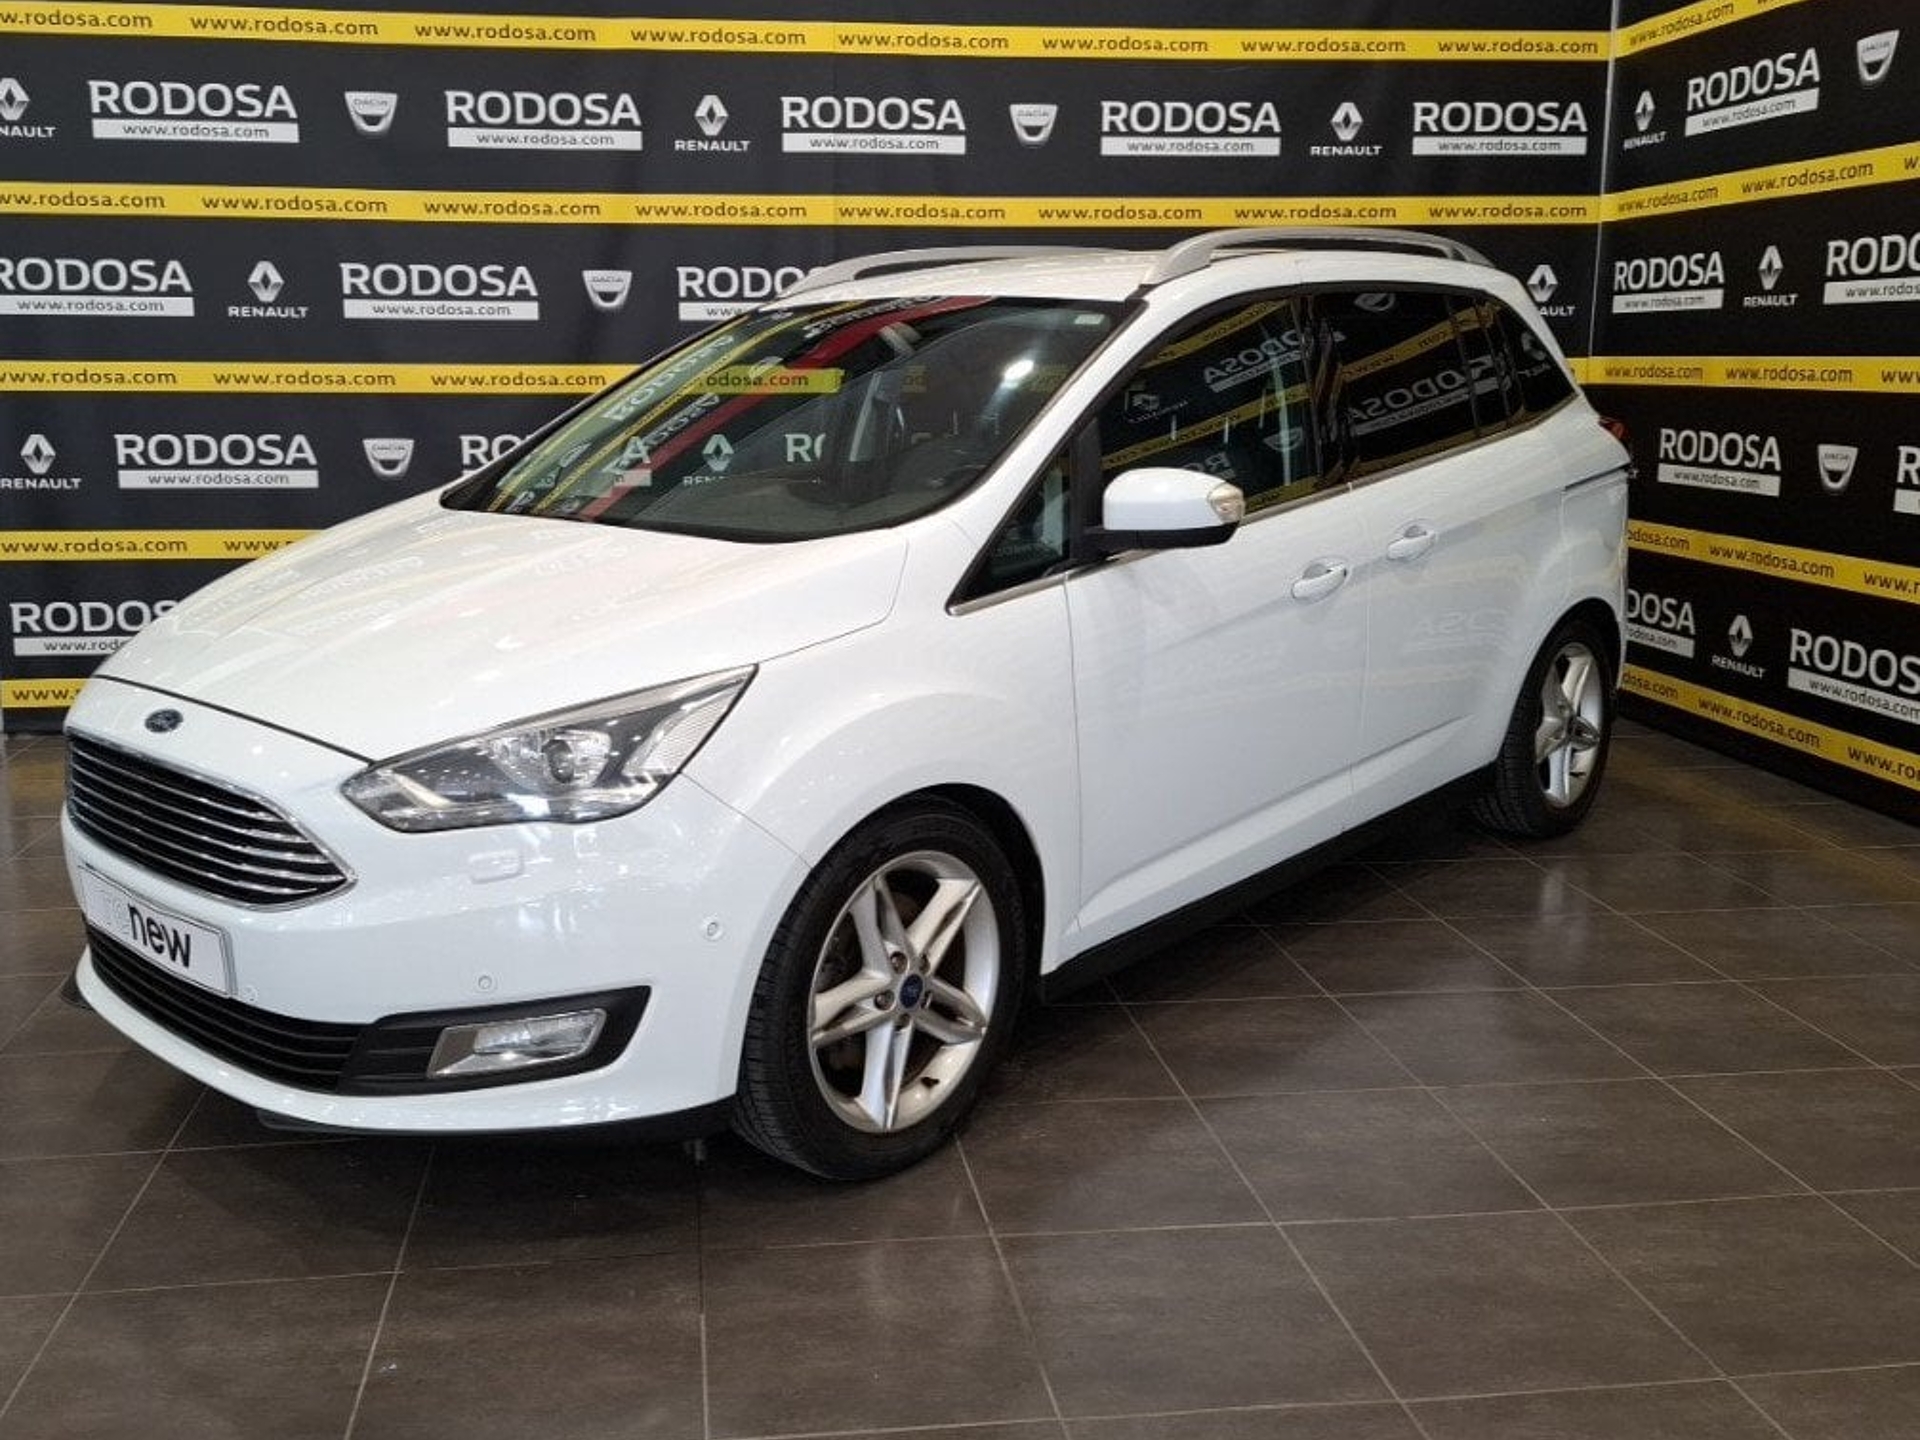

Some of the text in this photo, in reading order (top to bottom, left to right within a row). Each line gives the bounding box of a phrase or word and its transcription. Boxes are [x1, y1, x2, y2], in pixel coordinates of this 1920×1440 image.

[0, 9, 1598, 55] w.rodosa.com www.rodosa.com www.rodosa.com www.rodosa.com www.rodosa.com www.rodosa.com www.rodosa.com www.rodosa.com
[1629, 4, 1734, 46] www.rodosa.com
[1686, 48, 1821, 112] RODOSA
[88, 80, 298, 119] RODOSA
[445, 91, 642, 126] RODOSA
[780, 97, 966, 131] RODOSA
[1101, 101, 1281, 134] RODOSA
[1412, 101, 1588, 133] RODOSA
[1701, 99, 1796, 128] www.rodosa.com
[0, 126, 56, 138] NAULT
[122, 122, 270, 139] www.rodosa.com
[477, 132, 615, 147] www.rodosa.com
[809, 135, 940, 150] www.rodosa.com
[1622, 131, 1667, 150] RENAULT
[674, 140, 751, 152] RENAULT
[1127, 139, 1254, 153] www.rodosa.com
[1309, 145, 1383, 157] RENAULT
[1438, 140, 1561, 152] www.rodosa.com
[1617, 185, 1719, 213] www.rodosa.com
[1740, 161, 1874, 194] www.rodosa.com
[0, 190, 1587, 220] w.rodosa.com www.rodosa.com www.rodosa.com www.rodosa.com www.rodosa.com www.rodosa.com www.rodosa.com www.rodosa.com
[1826, 231, 1920, 277] ROD
[340, 263, 539, 297] RODOSA
[676, 266, 805, 298] RODO
[1613, 251, 1725, 291] RODOSA
[1742, 293, 1799, 308] RENAULT
[1845, 281, 1920, 298] www.rodos
[17, 298, 165, 313] www.rodosa.com
[228, 306, 309, 319] RENAULT
[372, 303, 512, 317] www.rodosa.com
[1539, 306, 1576, 317] AULT
[214, 372, 397, 388] www.rodosa.com
[431, 373, 607, 388] www.rodosa.com
[707, 373, 809, 386] odosa.com
[1604, 364, 1853, 383] www.rodosa.com www.rodosa.com
[113, 433, 318, 466] RODOSA
[1659, 428, 1782, 471] RODOSA
[0, 477, 82, 489] RENAULT
[148, 472, 290, 485] www.rodosa.com
[1673, 468, 1761, 490] www.rodosa.com
[1, 538, 188, 552] www.rodosa.com
[1709, 542, 1835, 578] www.rodosa.com
[9, 600, 179, 633] RODO
[1626, 588, 1695, 635] DOSA
[1711, 654, 1768, 680] RENAULT
[1790, 628, 1920, 695] RODOS
[1698, 697, 1821, 748] www.rodosa.com
